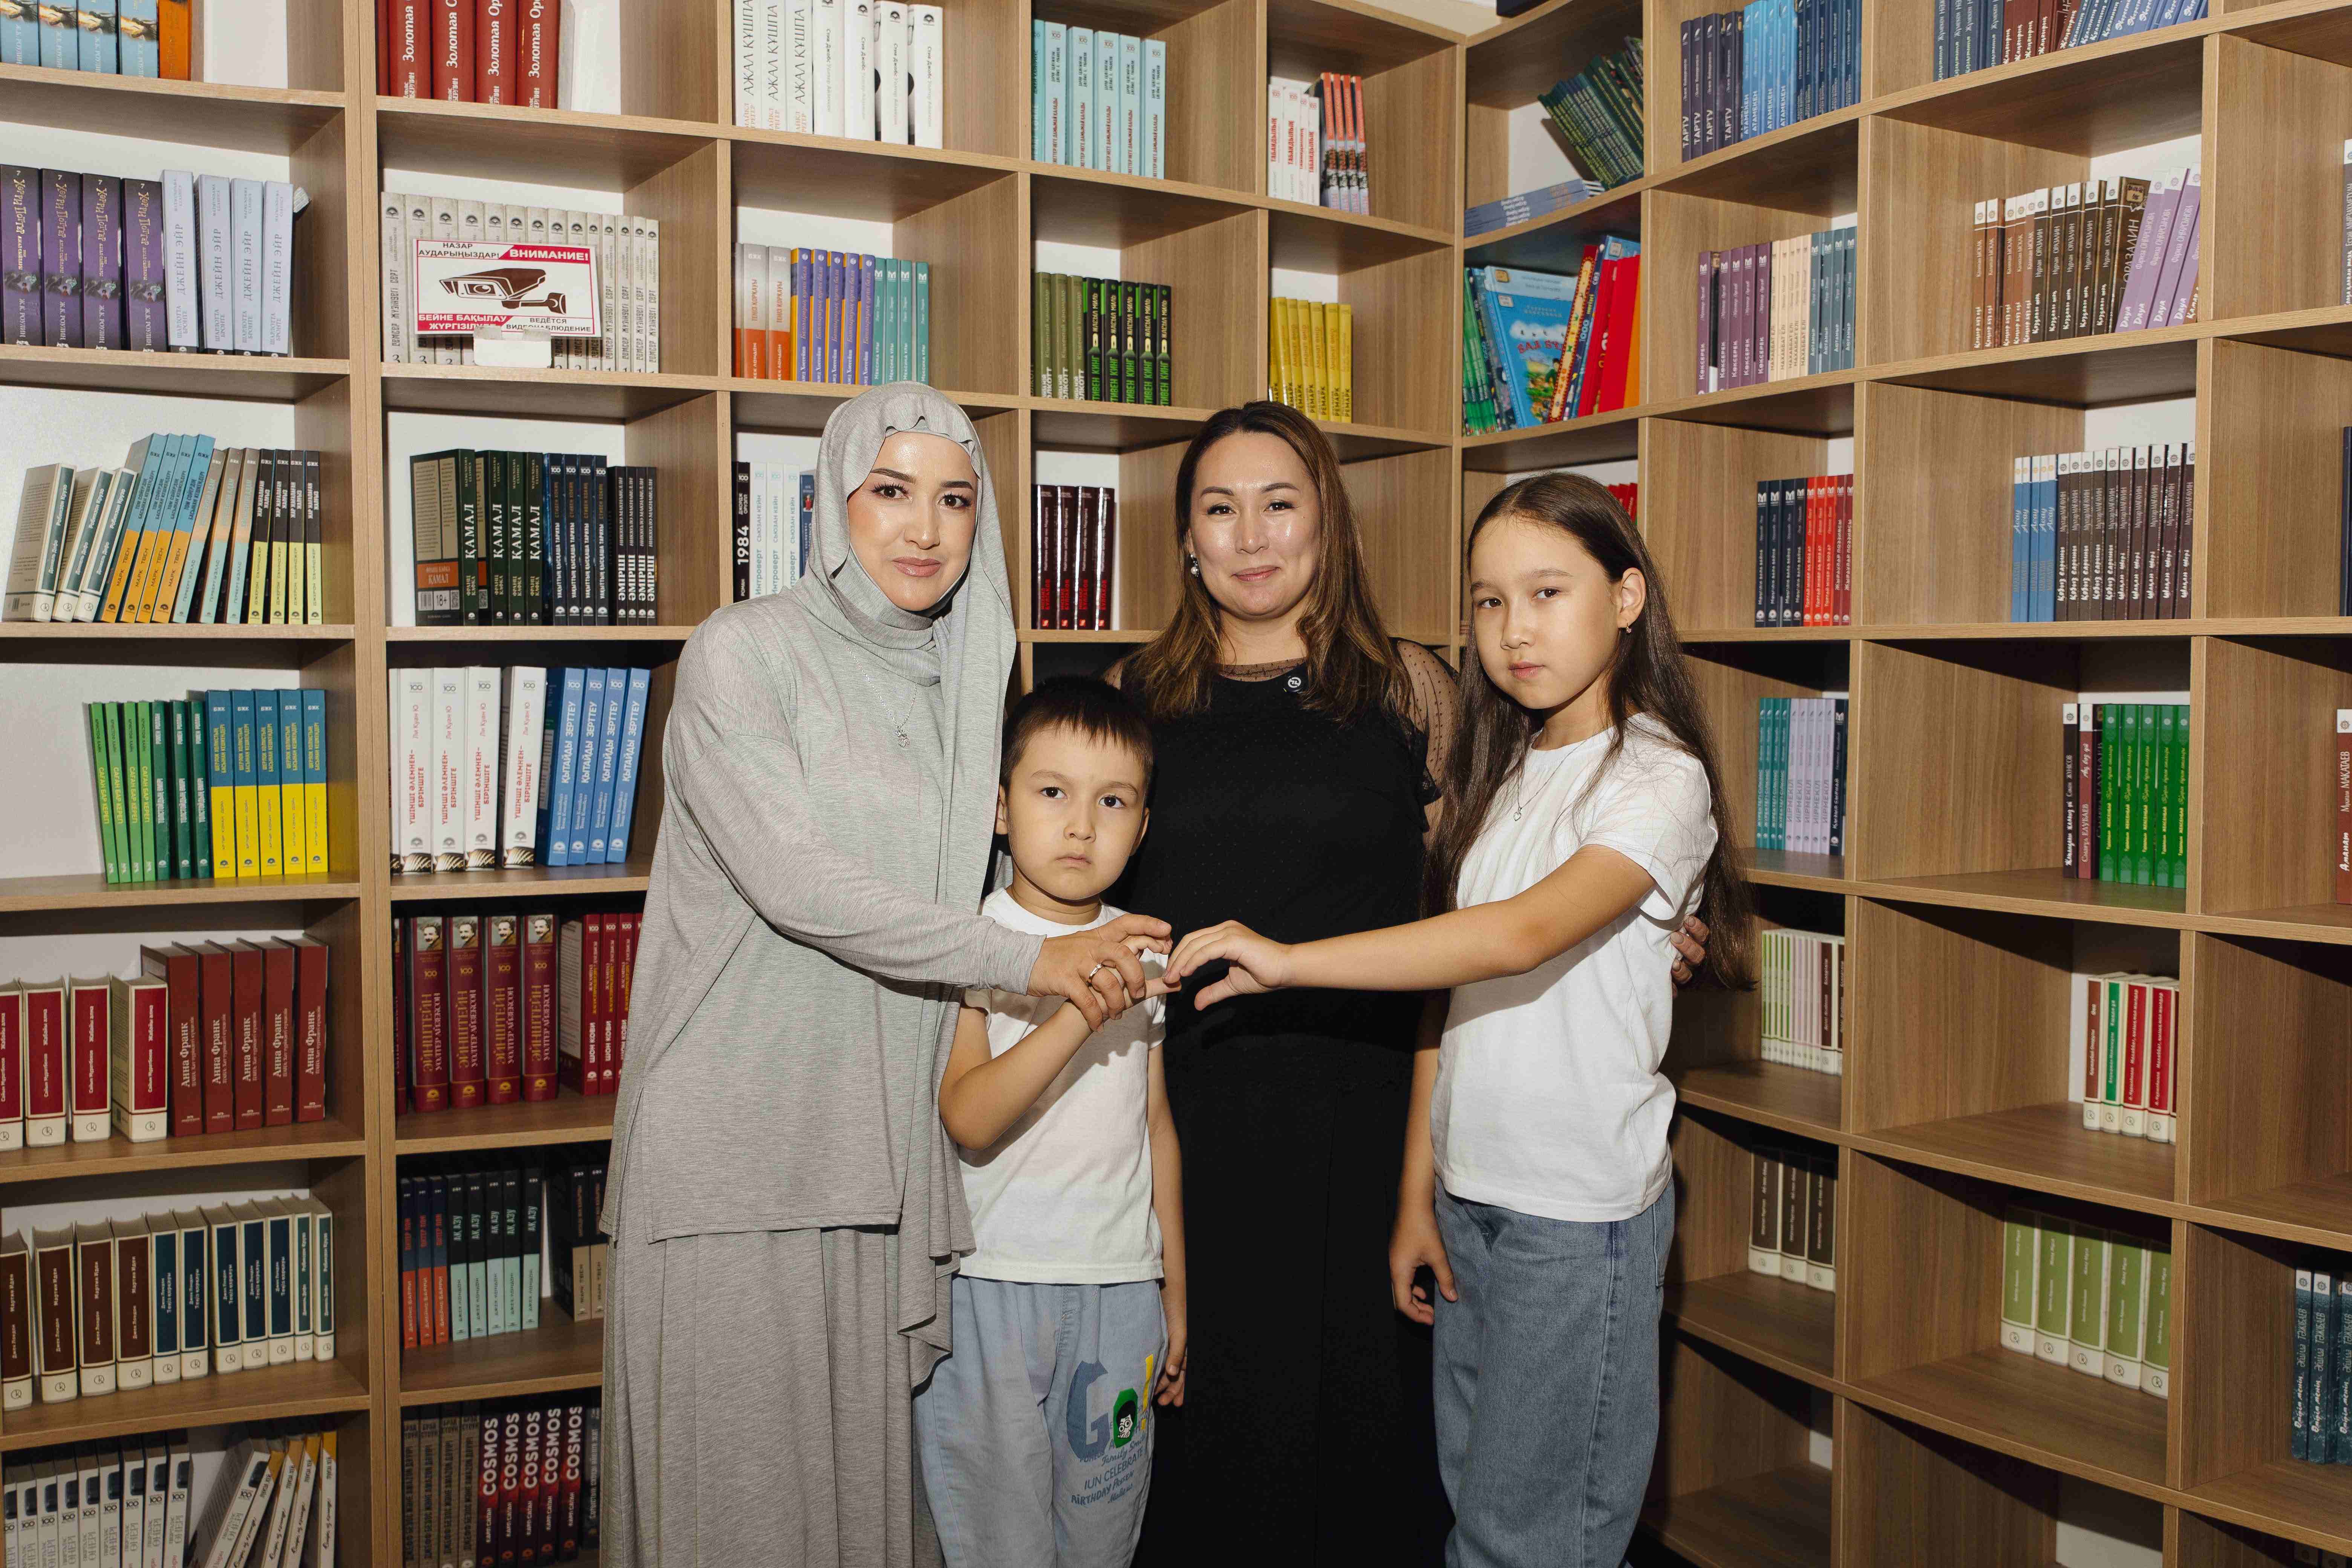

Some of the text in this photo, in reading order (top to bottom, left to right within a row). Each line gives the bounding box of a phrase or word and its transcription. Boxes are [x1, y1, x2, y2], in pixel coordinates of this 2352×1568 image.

[403, 6, 415, 62] Золотая
[446, 12, 458, 68] Золотая
[743, 54, 754, 96] АЖАЛ
[768, 60, 778, 101] АЖАЛ
[175, 224, 185, 295] ДЖЕЙН ЭЙР
[213, 228, 224, 299] ДЖЕЙН ЭЙР
[419, 250, 499, 259] АУДАРЫҢЫЗДАР!
[510, 250, 589, 261] ВНИМАНИЕ!
[455, 314, 507, 323] БАҚЫЛАУ
[1092, 355, 1100, 374] КИНГ
[464, 504, 476, 559] ҚАМАЛ
[493, 504, 505, 558] ҚАМАЛ
[737, 525, 749, 565] 1984
[167, 569, 176, 587] МАРК
[628, 554, 636, 601] ӘМІРШІ
[413, 730, 419, 738] Ли
[480, 727, 485, 736] Ли
[561, 701, 577, 783] ҚЫТАЙДЫ ЗЕРТТЕУ
[623, 700, 640, 782] ҚЫТАЙДЫ ЗЕРТТЕУ
[242, 1017, 254, 1082] Анна Франк
[419, 994, 433, 1071] ЭЙНШТЕЙН
[529, 985, 543, 1061] ЭЙНШТЕЙН
[179, 1022, 192, 1087] Анна Франк
[483, 1418, 498, 1496] COSMOS
[504, 1413, 520, 1490] COSMOS
